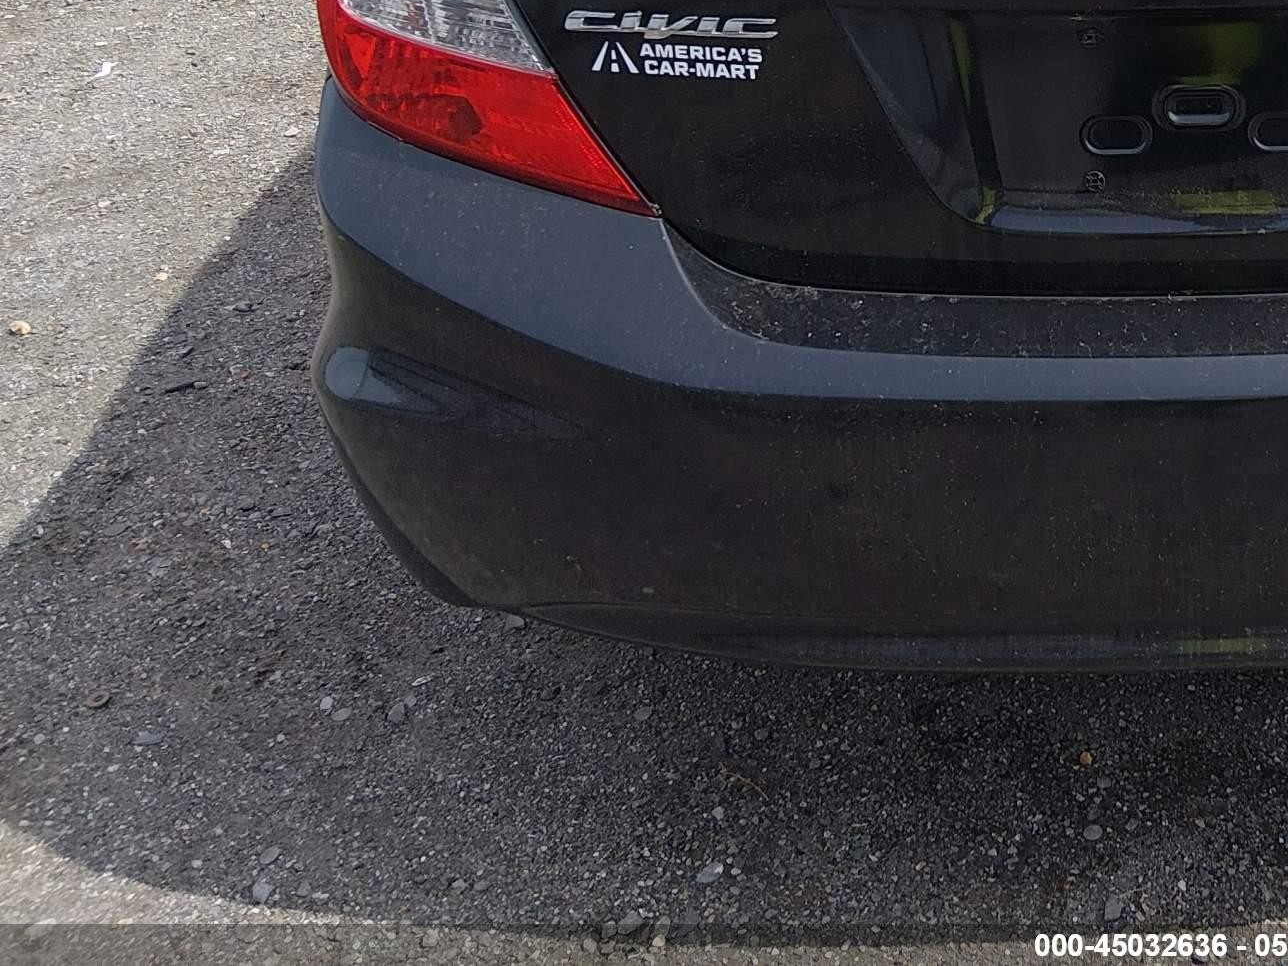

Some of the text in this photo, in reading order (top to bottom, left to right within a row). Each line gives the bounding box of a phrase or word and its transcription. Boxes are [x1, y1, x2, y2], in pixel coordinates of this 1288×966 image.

[564, 10, 779, 40] CIVIC
[639, 43, 763, 63] AMERICA'S
[644, 60, 760, 80] CAR-MART
